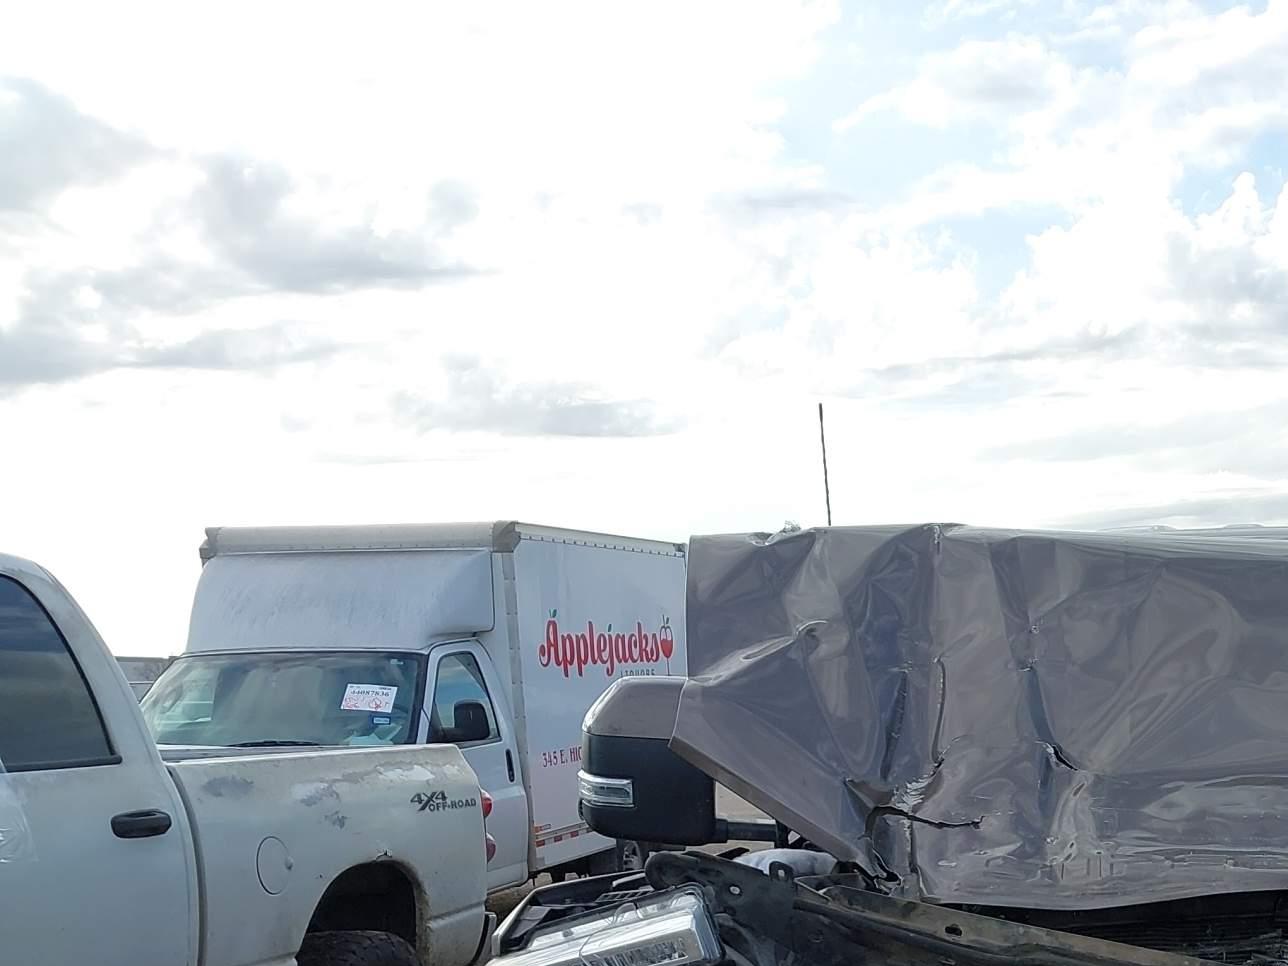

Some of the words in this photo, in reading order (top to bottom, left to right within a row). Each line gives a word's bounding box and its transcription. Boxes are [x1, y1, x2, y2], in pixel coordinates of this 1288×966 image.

[538, 615, 661, 678] Applejacks
[542, 751, 558, 768] 345
[560, 749, 568, 764] E.
